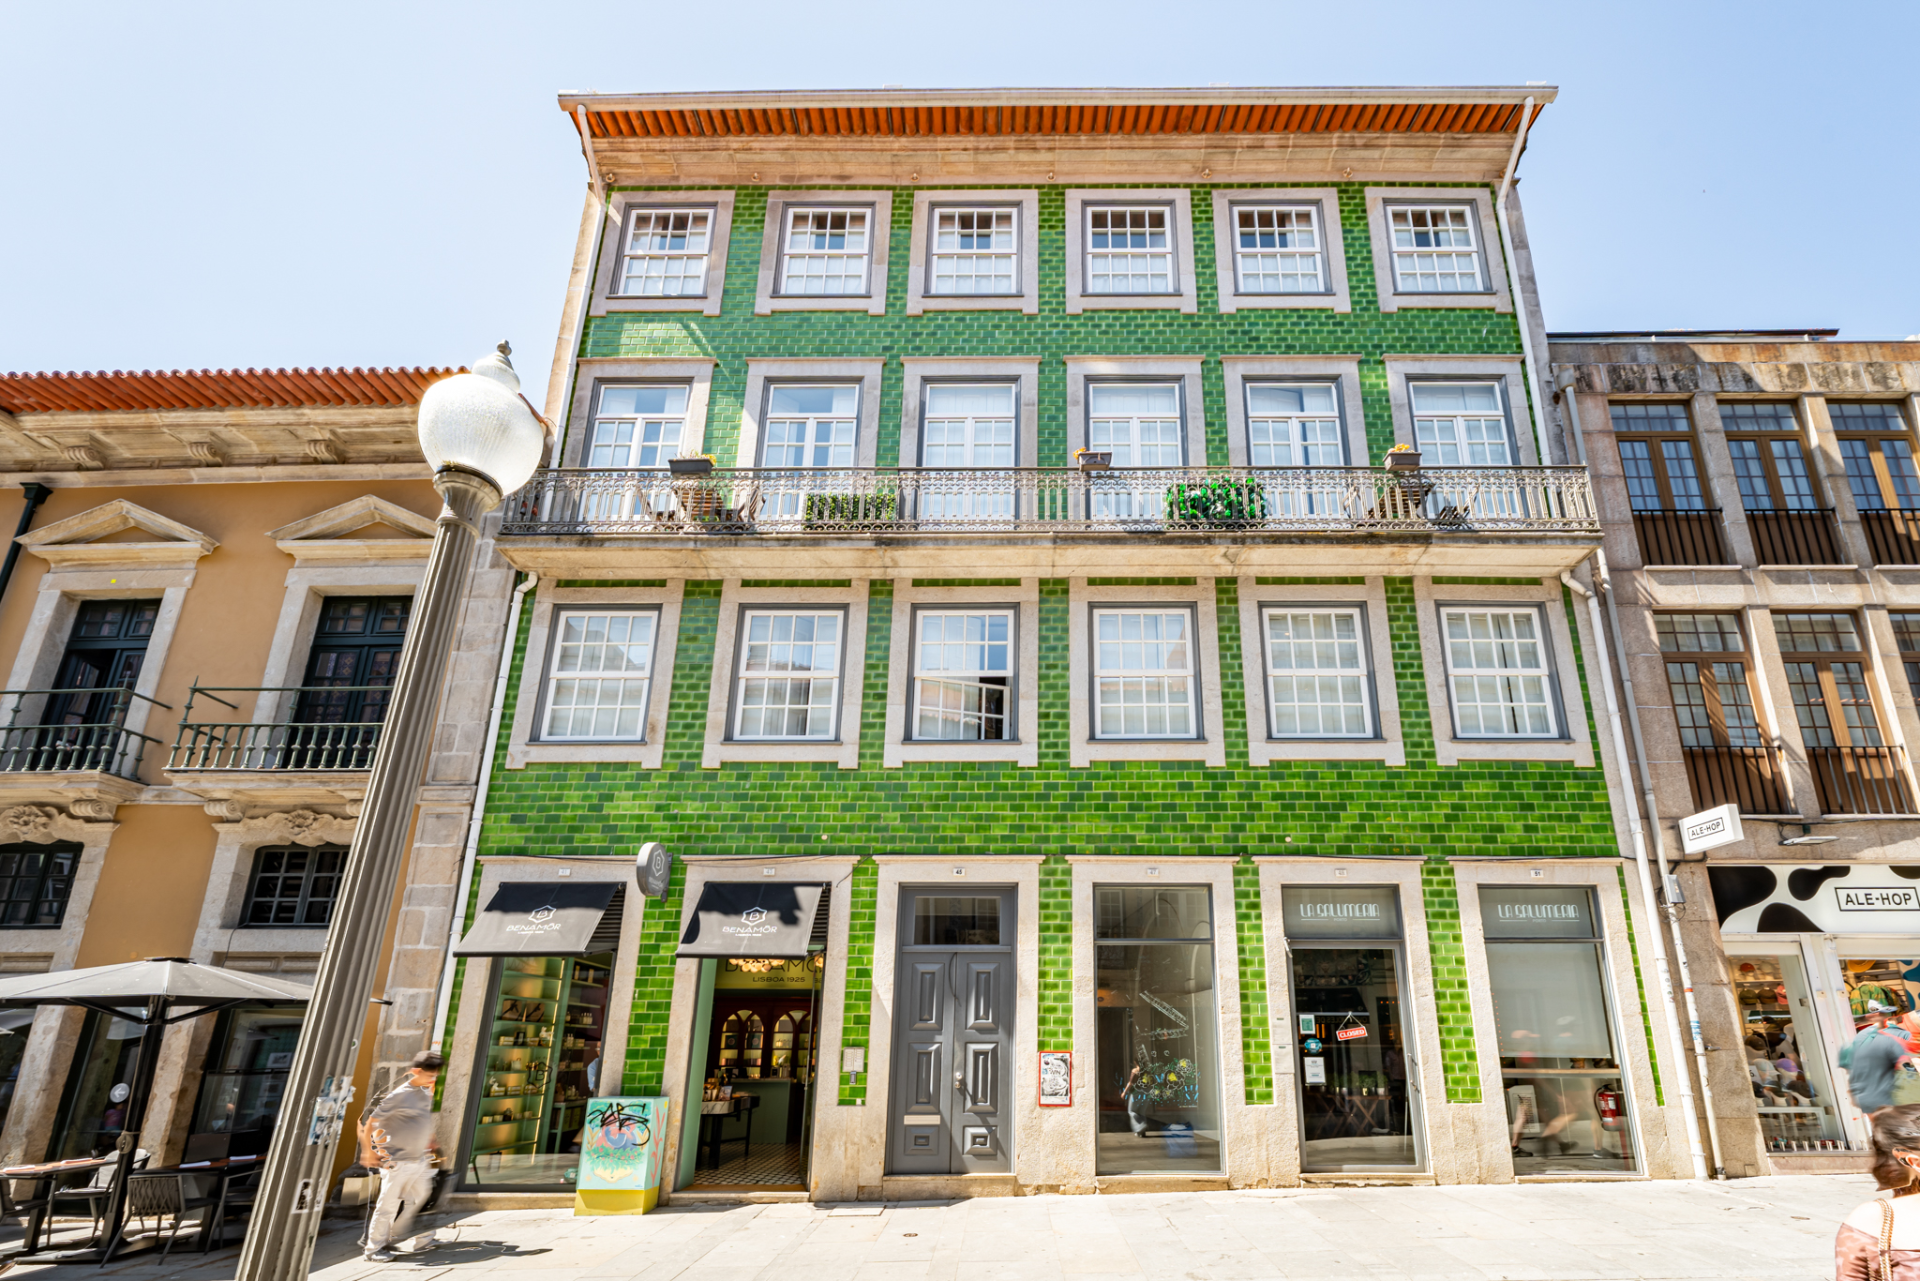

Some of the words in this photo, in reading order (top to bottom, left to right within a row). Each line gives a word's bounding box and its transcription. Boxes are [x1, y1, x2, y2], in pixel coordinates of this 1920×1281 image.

[1691, 821, 1721, 837] ALE-HOP
[1845, 892, 1912, 906] ALE-HOP
[749, 912, 760, 921] B
[1300, 903, 1315, 917] LA
[1316, 903, 1380, 917] SALUMERIA
[1497, 904, 1513, 918] LA
[1514, 904, 1580, 918] SALUMERIA
[1339, 1029, 1365, 1039] CLOSED
